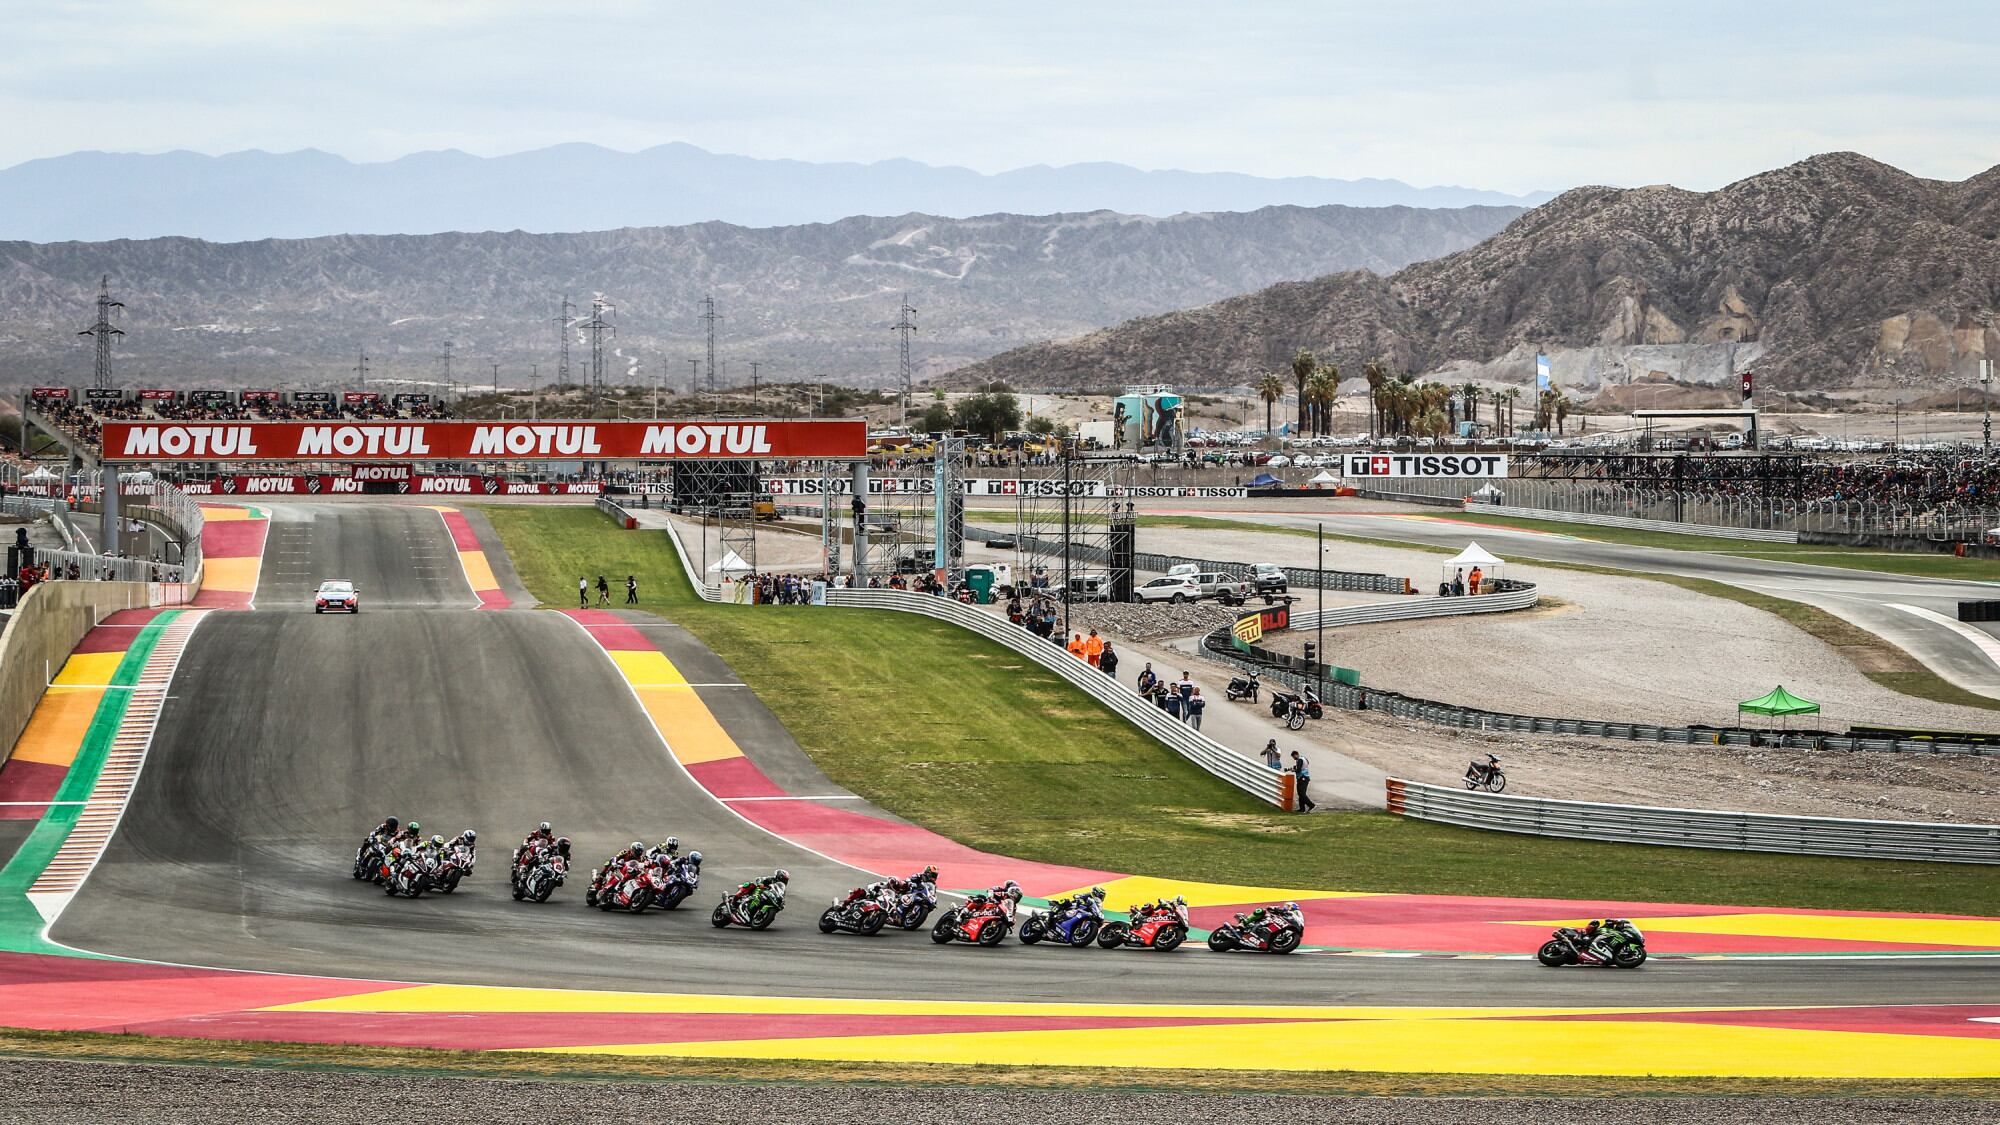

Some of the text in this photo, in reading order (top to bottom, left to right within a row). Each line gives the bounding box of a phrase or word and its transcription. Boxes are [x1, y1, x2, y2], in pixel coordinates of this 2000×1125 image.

[1743, 381, 1750, 390] 9
[124, 425, 772, 455] MOTUL MOTUL MOTUL MOTUL
[1393, 457, 1501, 475] TISSOT
[355, 467, 409, 479] MOTUL
[183, 484, 212, 494] MOTUL
[246, 478, 294, 492] MOTUL
[332, 478, 364, 492] MOT
[420, 478, 471, 492] MOTUL
[508, 484, 539, 494] MOTUL
[567, 483, 600, 494] MOTUL
[648, 484, 673, 493] TISS
[898, 479, 976, 493] TIST
[1018, 480, 1098, 495] TISSOT
[1126, 487, 1175, 496] TISSOT
[1197, 487, 1246, 497] TISSOT
